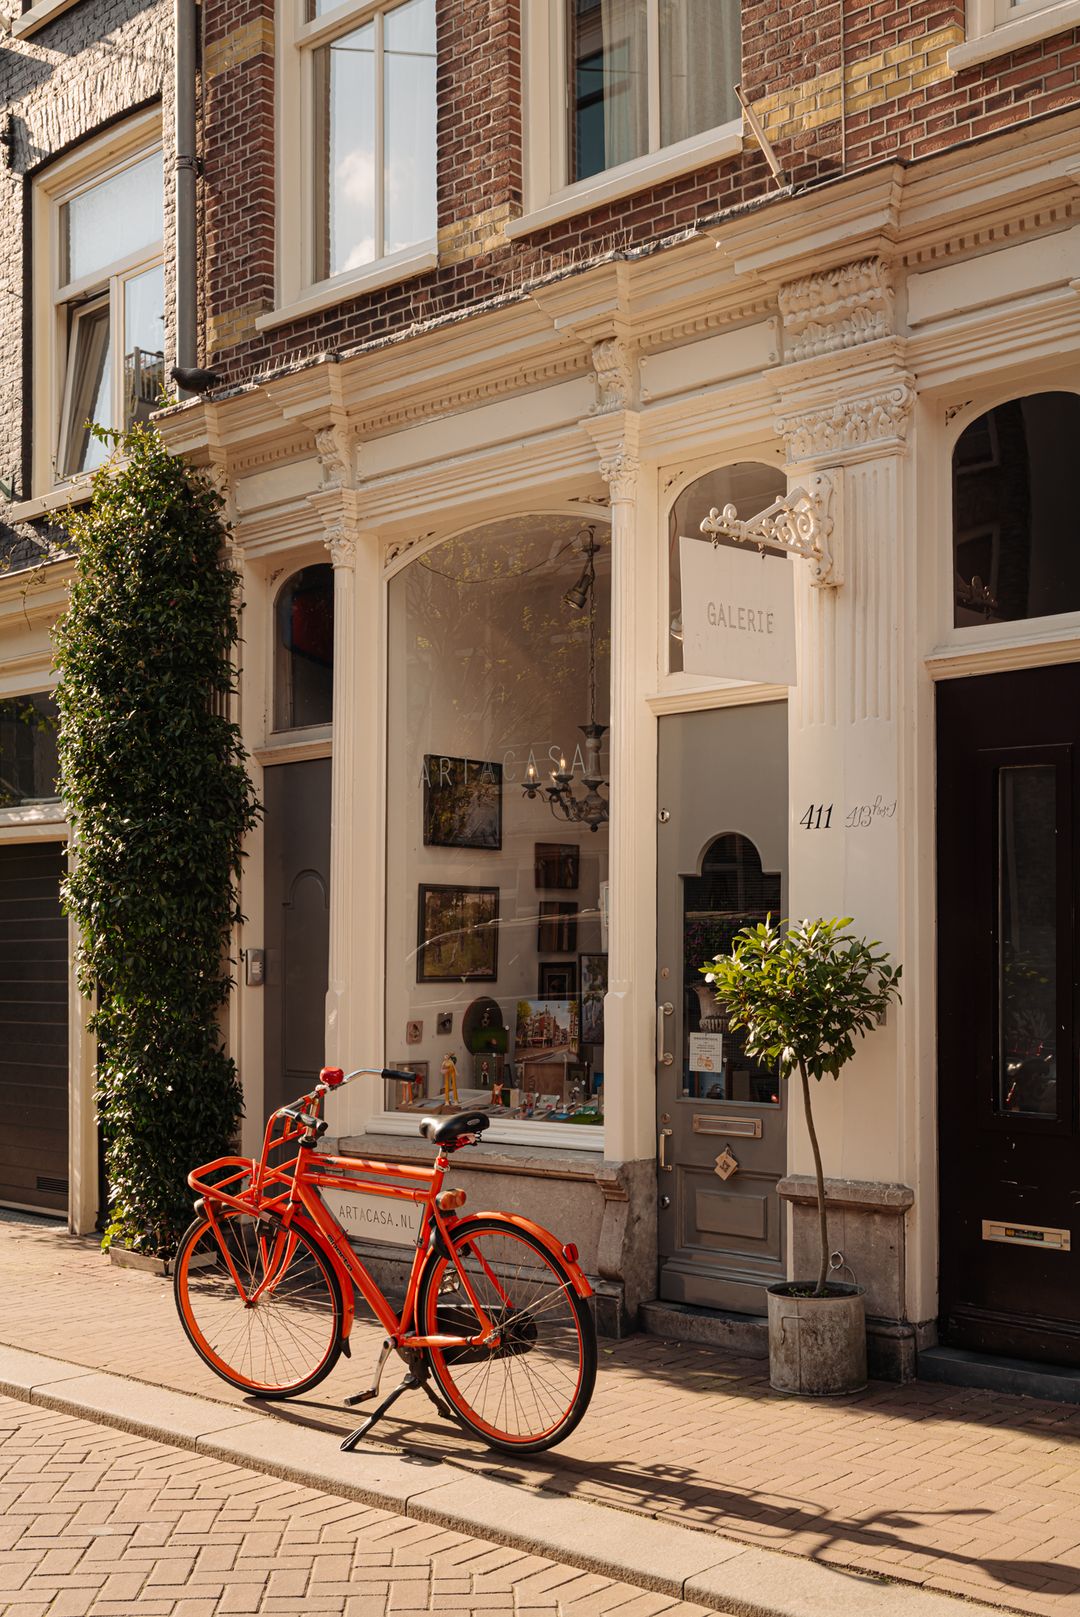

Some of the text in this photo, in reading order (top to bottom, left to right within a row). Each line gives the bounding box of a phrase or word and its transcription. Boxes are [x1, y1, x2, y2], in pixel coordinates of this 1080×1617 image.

[707, 601, 774, 634] GALERIE
[800, 803, 834, 830] 411
[339, 1205, 414, 1229] ARTACASA.NL
